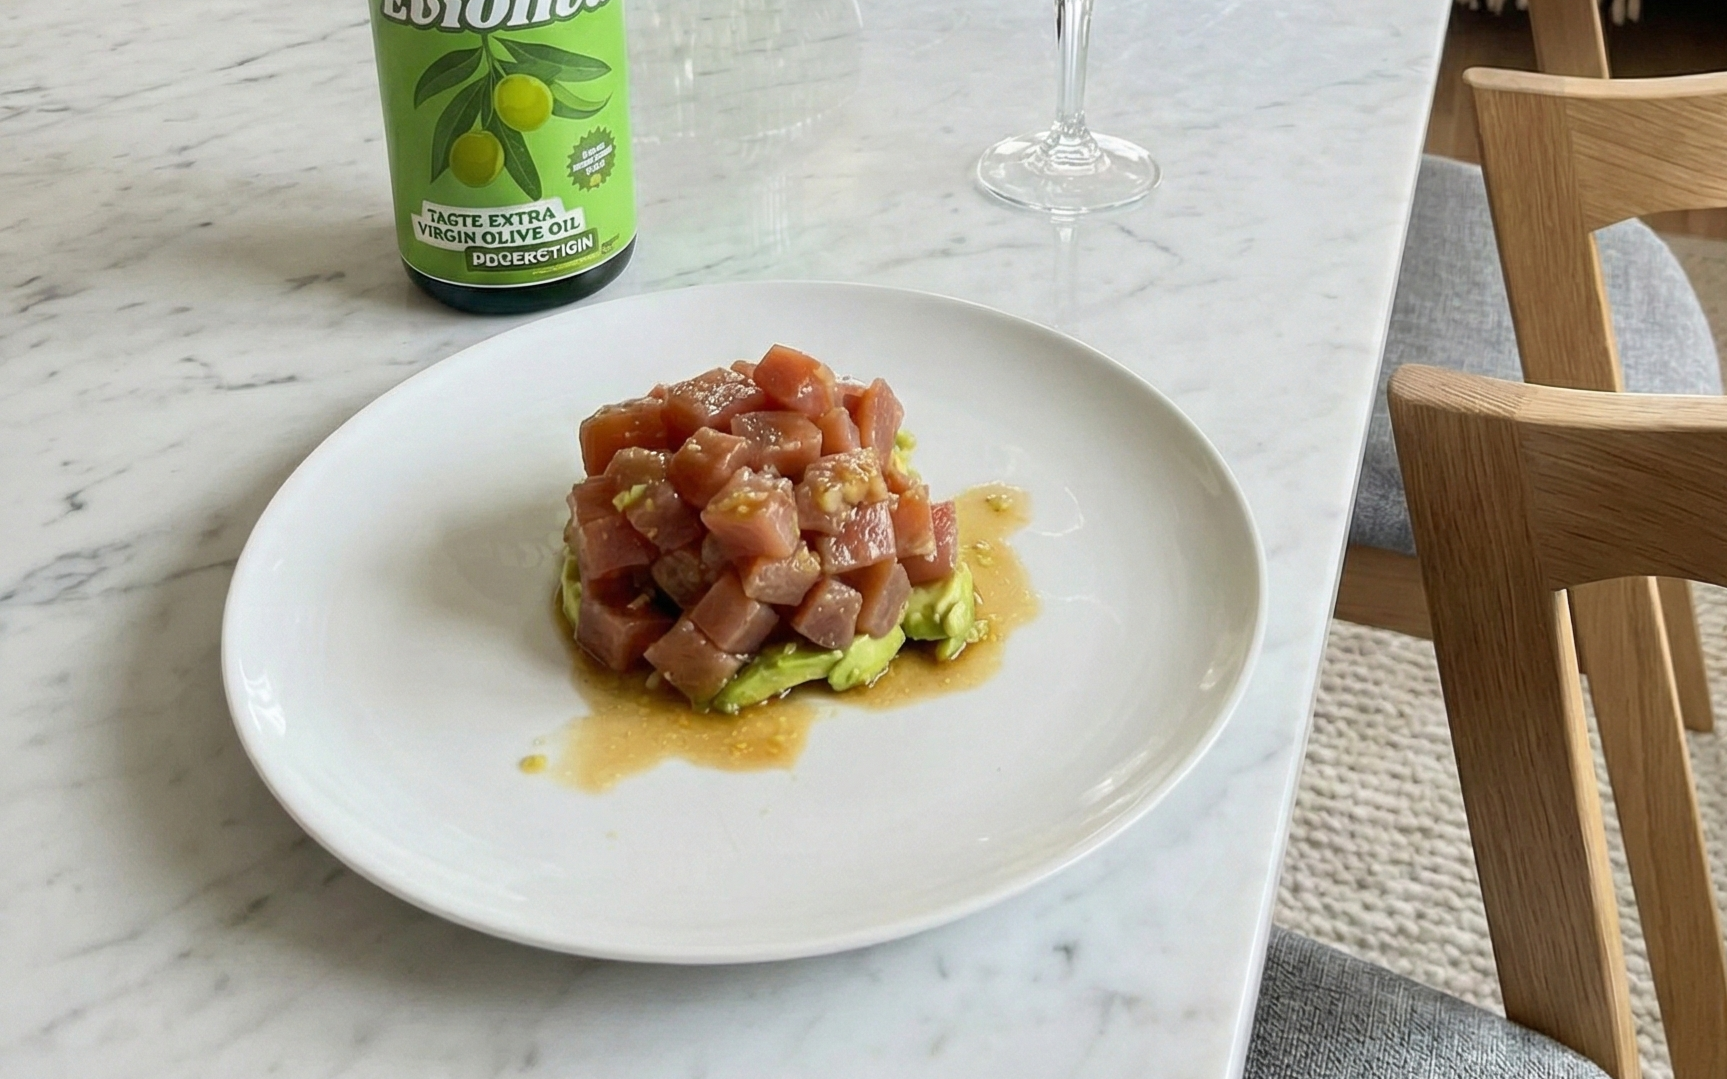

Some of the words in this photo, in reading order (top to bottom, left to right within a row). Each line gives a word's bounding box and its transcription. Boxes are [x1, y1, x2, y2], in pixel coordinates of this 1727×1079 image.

[489, 206, 556, 228] EXTRA
[417, 220, 477, 245] VIRGIN
[481, 226, 544, 246] OLIVE
[548, 216, 581, 236] OIL
